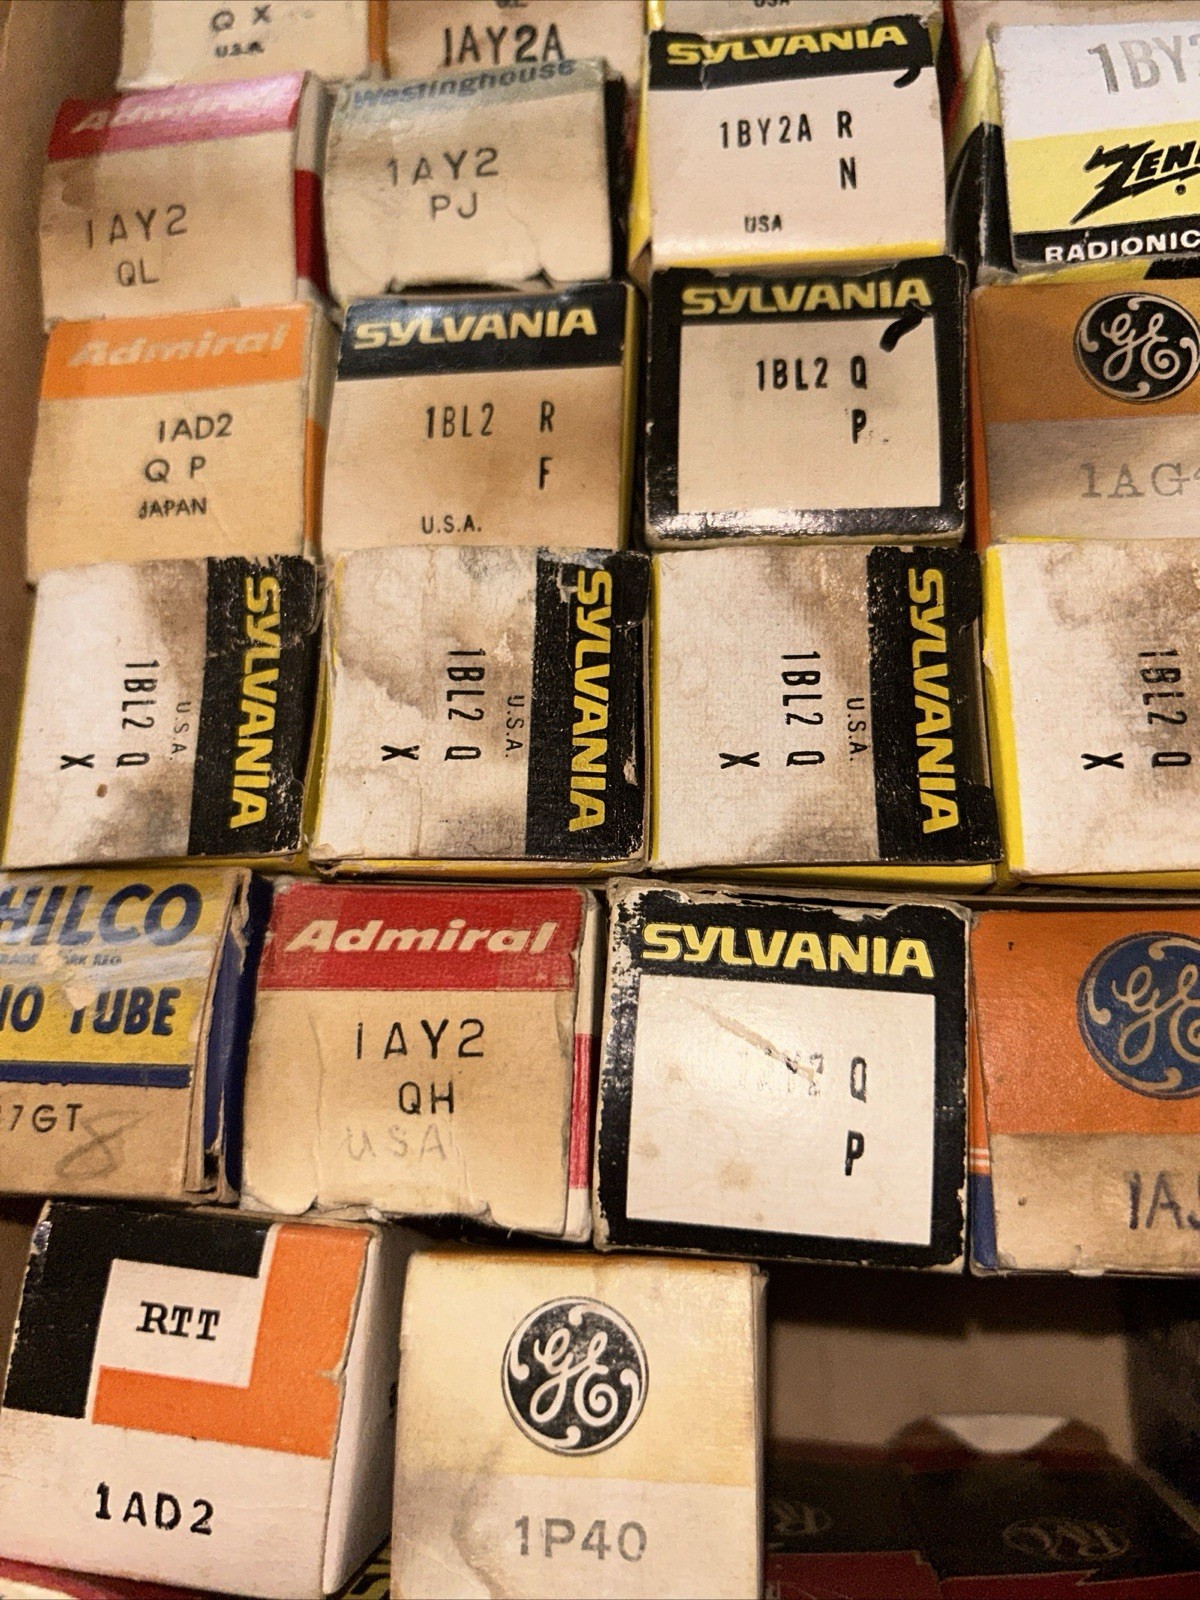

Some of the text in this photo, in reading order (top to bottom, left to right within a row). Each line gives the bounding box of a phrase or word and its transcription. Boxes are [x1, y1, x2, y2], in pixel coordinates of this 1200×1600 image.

[251, 4, 272, 26] X
[666, 23, 909, 66] SYLVANIA
[353, 58, 578, 108] Westinghouse
[718, 109, 854, 150] 1BY2A R
[838, 156, 858, 191] N
[429, 193, 480, 221] PJ
[743, 213, 783, 234] USA
[1044, 229, 1200, 264] RADIONIC
[116, 258, 161, 288] QL
[681, 277, 934, 317] SYLVANIA
[66, 321, 291, 368] Admiral
[353, 306, 598, 350] SYLVANIA
[756, 355, 829, 393] 1BL2
[425, 401, 555, 440] 1BL2 R
[850, 408, 868, 445] P
[143, 455, 207, 484] Q P
[538, 455, 553, 491] F
[137, 497, 208, 520] JAPAN
[421, 513, 483, 535] U.S.A.
[121, 658, 161, 731] 1BL2
[230, 575, 281, 830] SYLVANIA
[446, 646, 486, 723] 1BL2
[568, 568, 614, 833] SYLVANIA
[781, 650, 824, 727] 1BL2
[907, 566, 960, 836] SYLVANIA
[1138, 648, 1188, 725] 1BL2
[60, 752, 96, 771] X
[380, 743, 420, 763] X
[718, 750, 761, 770] X
[1081, 751, 1125, 771] X
[284, 918, 559, 955] Admiral
[641, 922, 936, 980] SYLVANIA
[398, 1080, 455, 1116] QH
[849, 1056, 867, 1104] Q
[845, 1130, 866, 1177] P
[135, 1299, 221, 1343] RTT
[93, 1479, 216, 1538] 1AD2
[514, 1514, 648, 1563] 1P40
